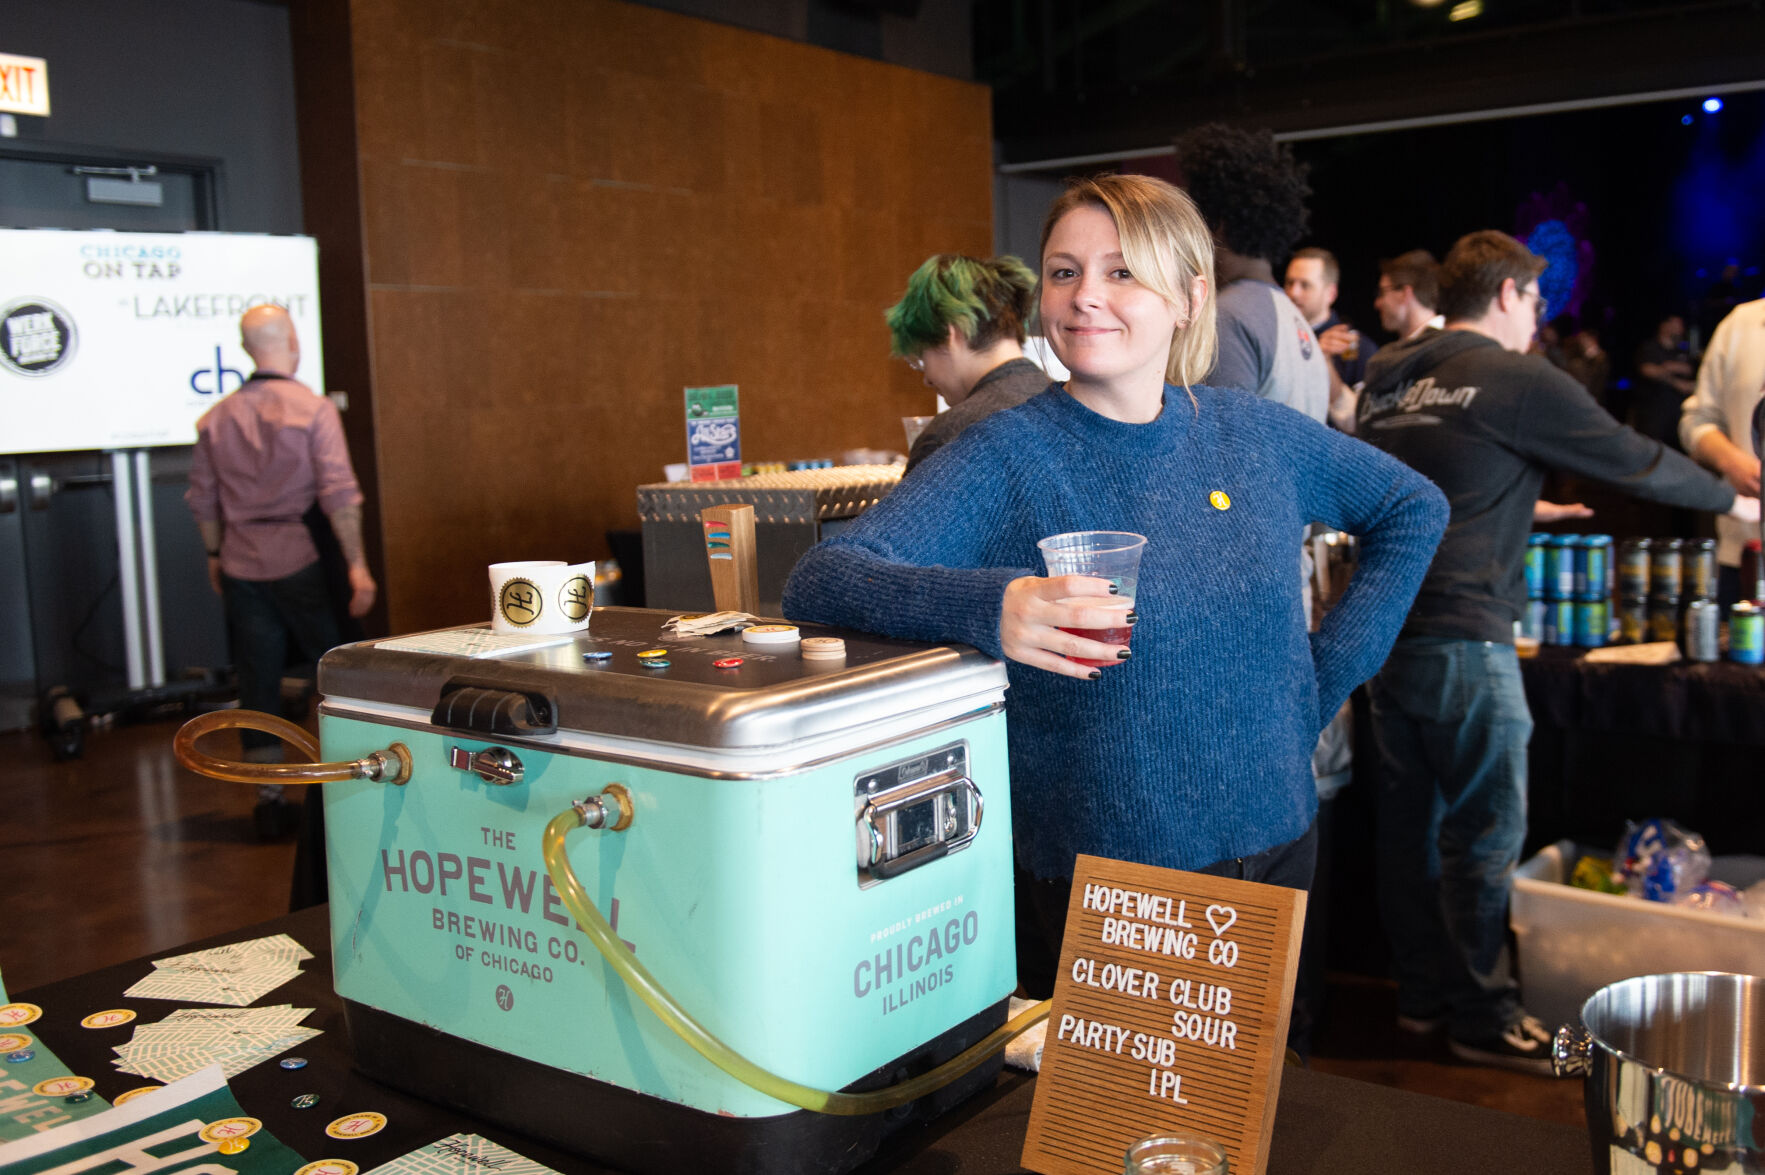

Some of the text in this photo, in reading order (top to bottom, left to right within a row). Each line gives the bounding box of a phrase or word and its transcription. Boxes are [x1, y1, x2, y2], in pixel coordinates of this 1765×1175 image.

[0, 65, 36, 104] XIT
[80, 245, 182, 259] CHICAGO
[83, 261, 182, 279] ON TAP
[480, 827, 516, 850] THE
[381, 849, 636, 954] HOPEWEL
[870, 894, 963, 943] PROUDLY BREWED IN
[1083, 883, 1192, 928] HOPEWELL
[432, 908, 585, 966] BREWING CO.
[853, 910, 978, 998] CHICAGO
[1102, 917, 1239, 968] BREWING CO
[455, 945, 554, 983] OF CHICAGO
[1072, 958, 1232, 1015] CLOVER CLUB
[882, 964, 954, 1015] ILLINOIS
[1057, 1014, 1176, 1067] PARTY SUB
[1171, 1010, 1238, 1050] SOUR
